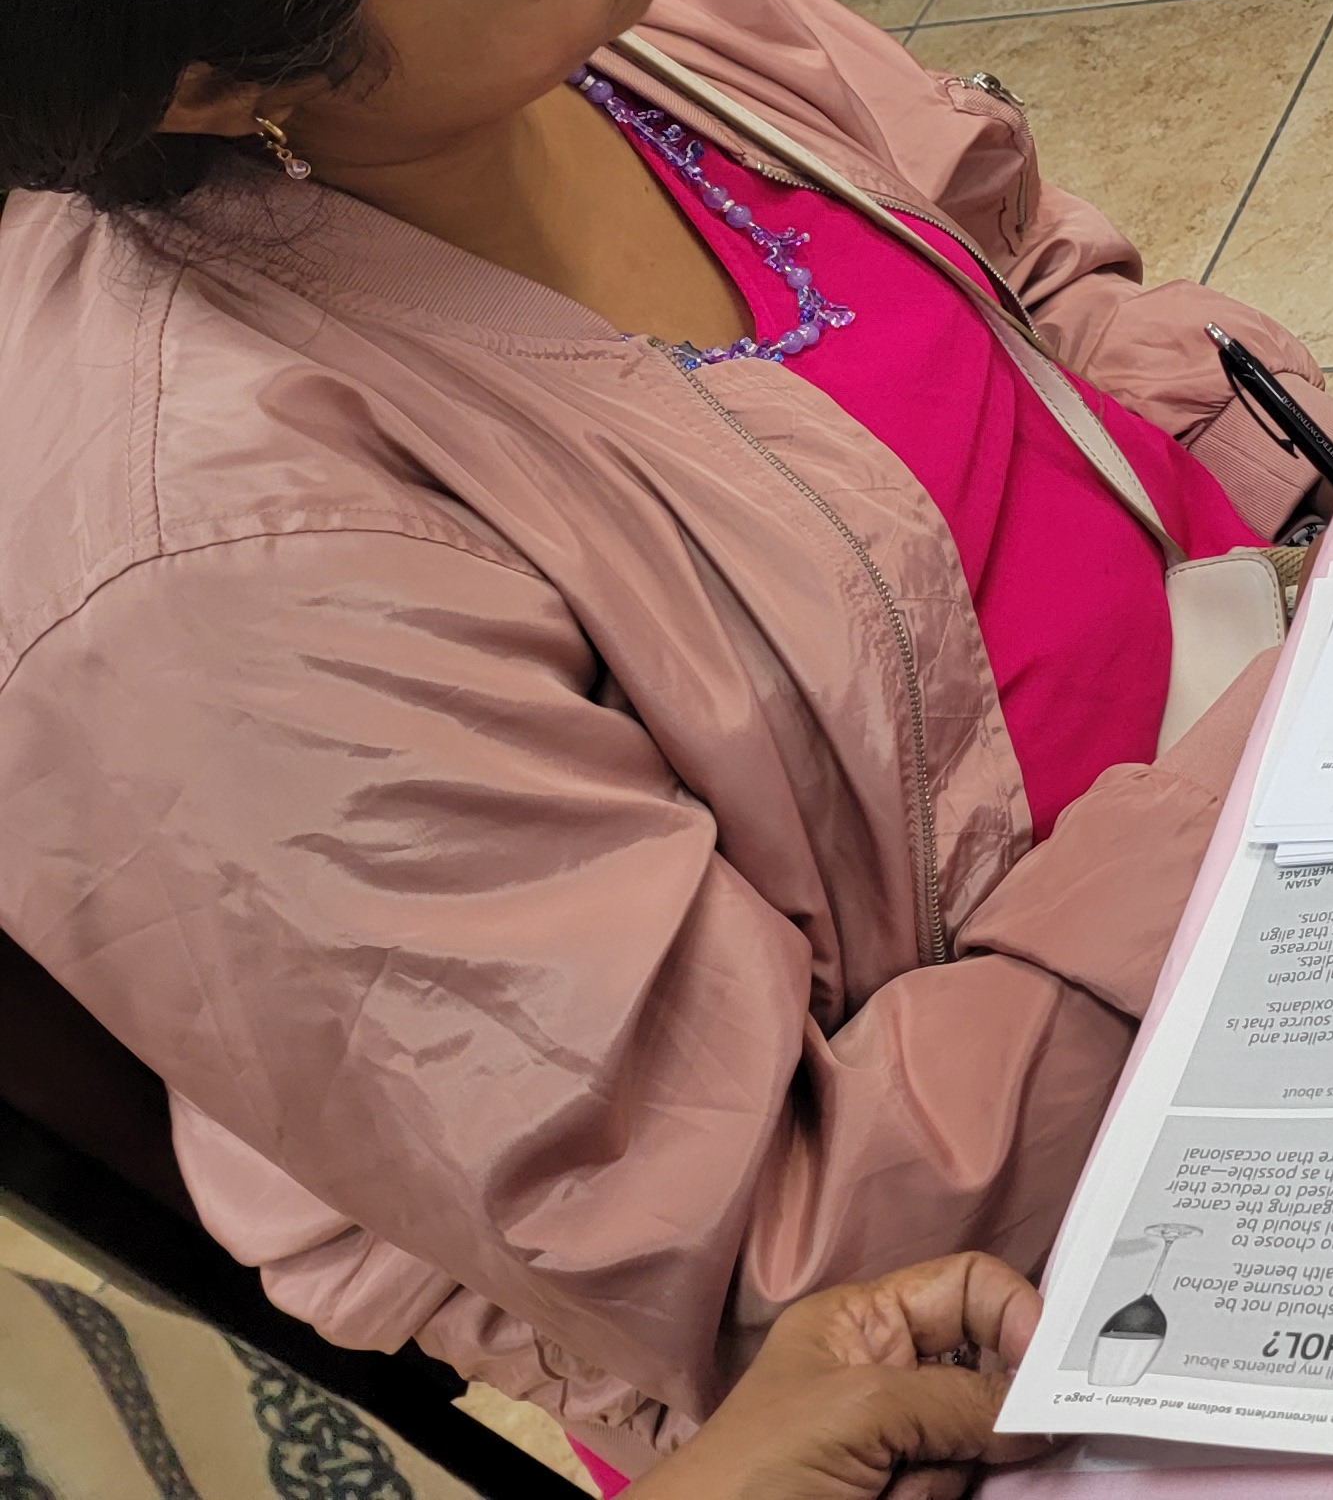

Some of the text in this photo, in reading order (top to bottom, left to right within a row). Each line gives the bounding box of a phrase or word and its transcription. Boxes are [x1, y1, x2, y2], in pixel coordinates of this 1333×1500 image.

[1232, 1262, 1298, 1281] benefit.
[1172, 1276, 1239, 1295] alcohol
[1243, 1280, 1324, 1297] consume
[1214, 1296, 1238, 1313] be
[1240, 1298, 1273, 1313] not
[1183, 1354, 1230, 1371] about
[1231, 1359, 1297, 1375] patients
[1298, 1360, 1324, 1376] my
[1052, 1393, 1063, 1405] 2
[1063, 1391, 1096, 1403] page
[1105, 1393, 1158, 1408] calcium)
[1159, 1399, 1185, 1410] and
[1186, 1402, 1233, 1415] sodium
[1234, 1407, 1329, 1424] micronutrients
